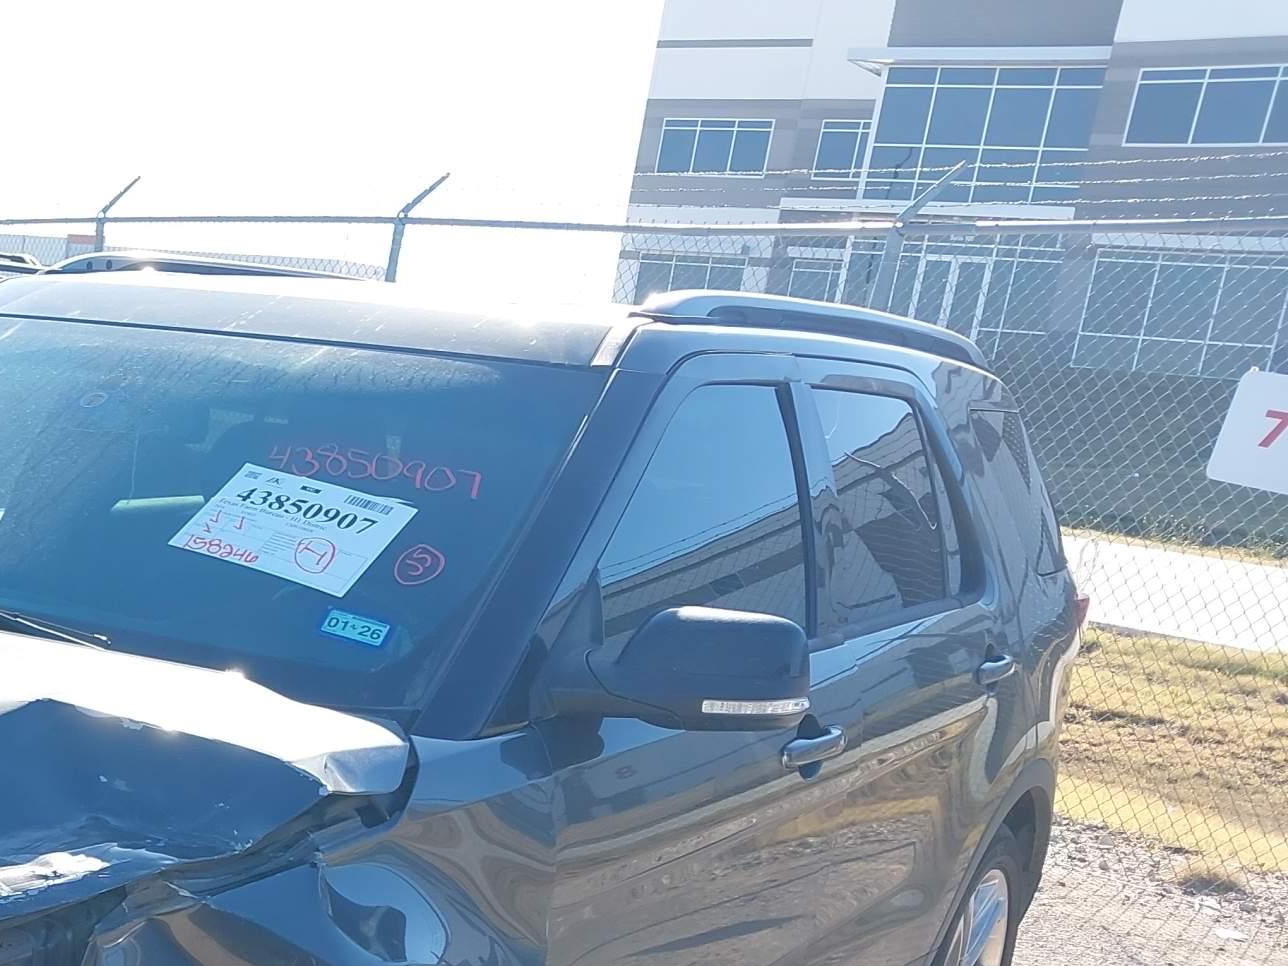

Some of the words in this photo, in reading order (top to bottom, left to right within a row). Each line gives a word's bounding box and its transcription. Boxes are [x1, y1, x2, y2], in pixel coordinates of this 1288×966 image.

[1257, 408, 1288, 448] 7
[269, 443, 482, 500] 43850907
[237, 486, 379, 534] 43850907
[327, 616, 350, 632] 01
[358, 624, 384, 641] 26
